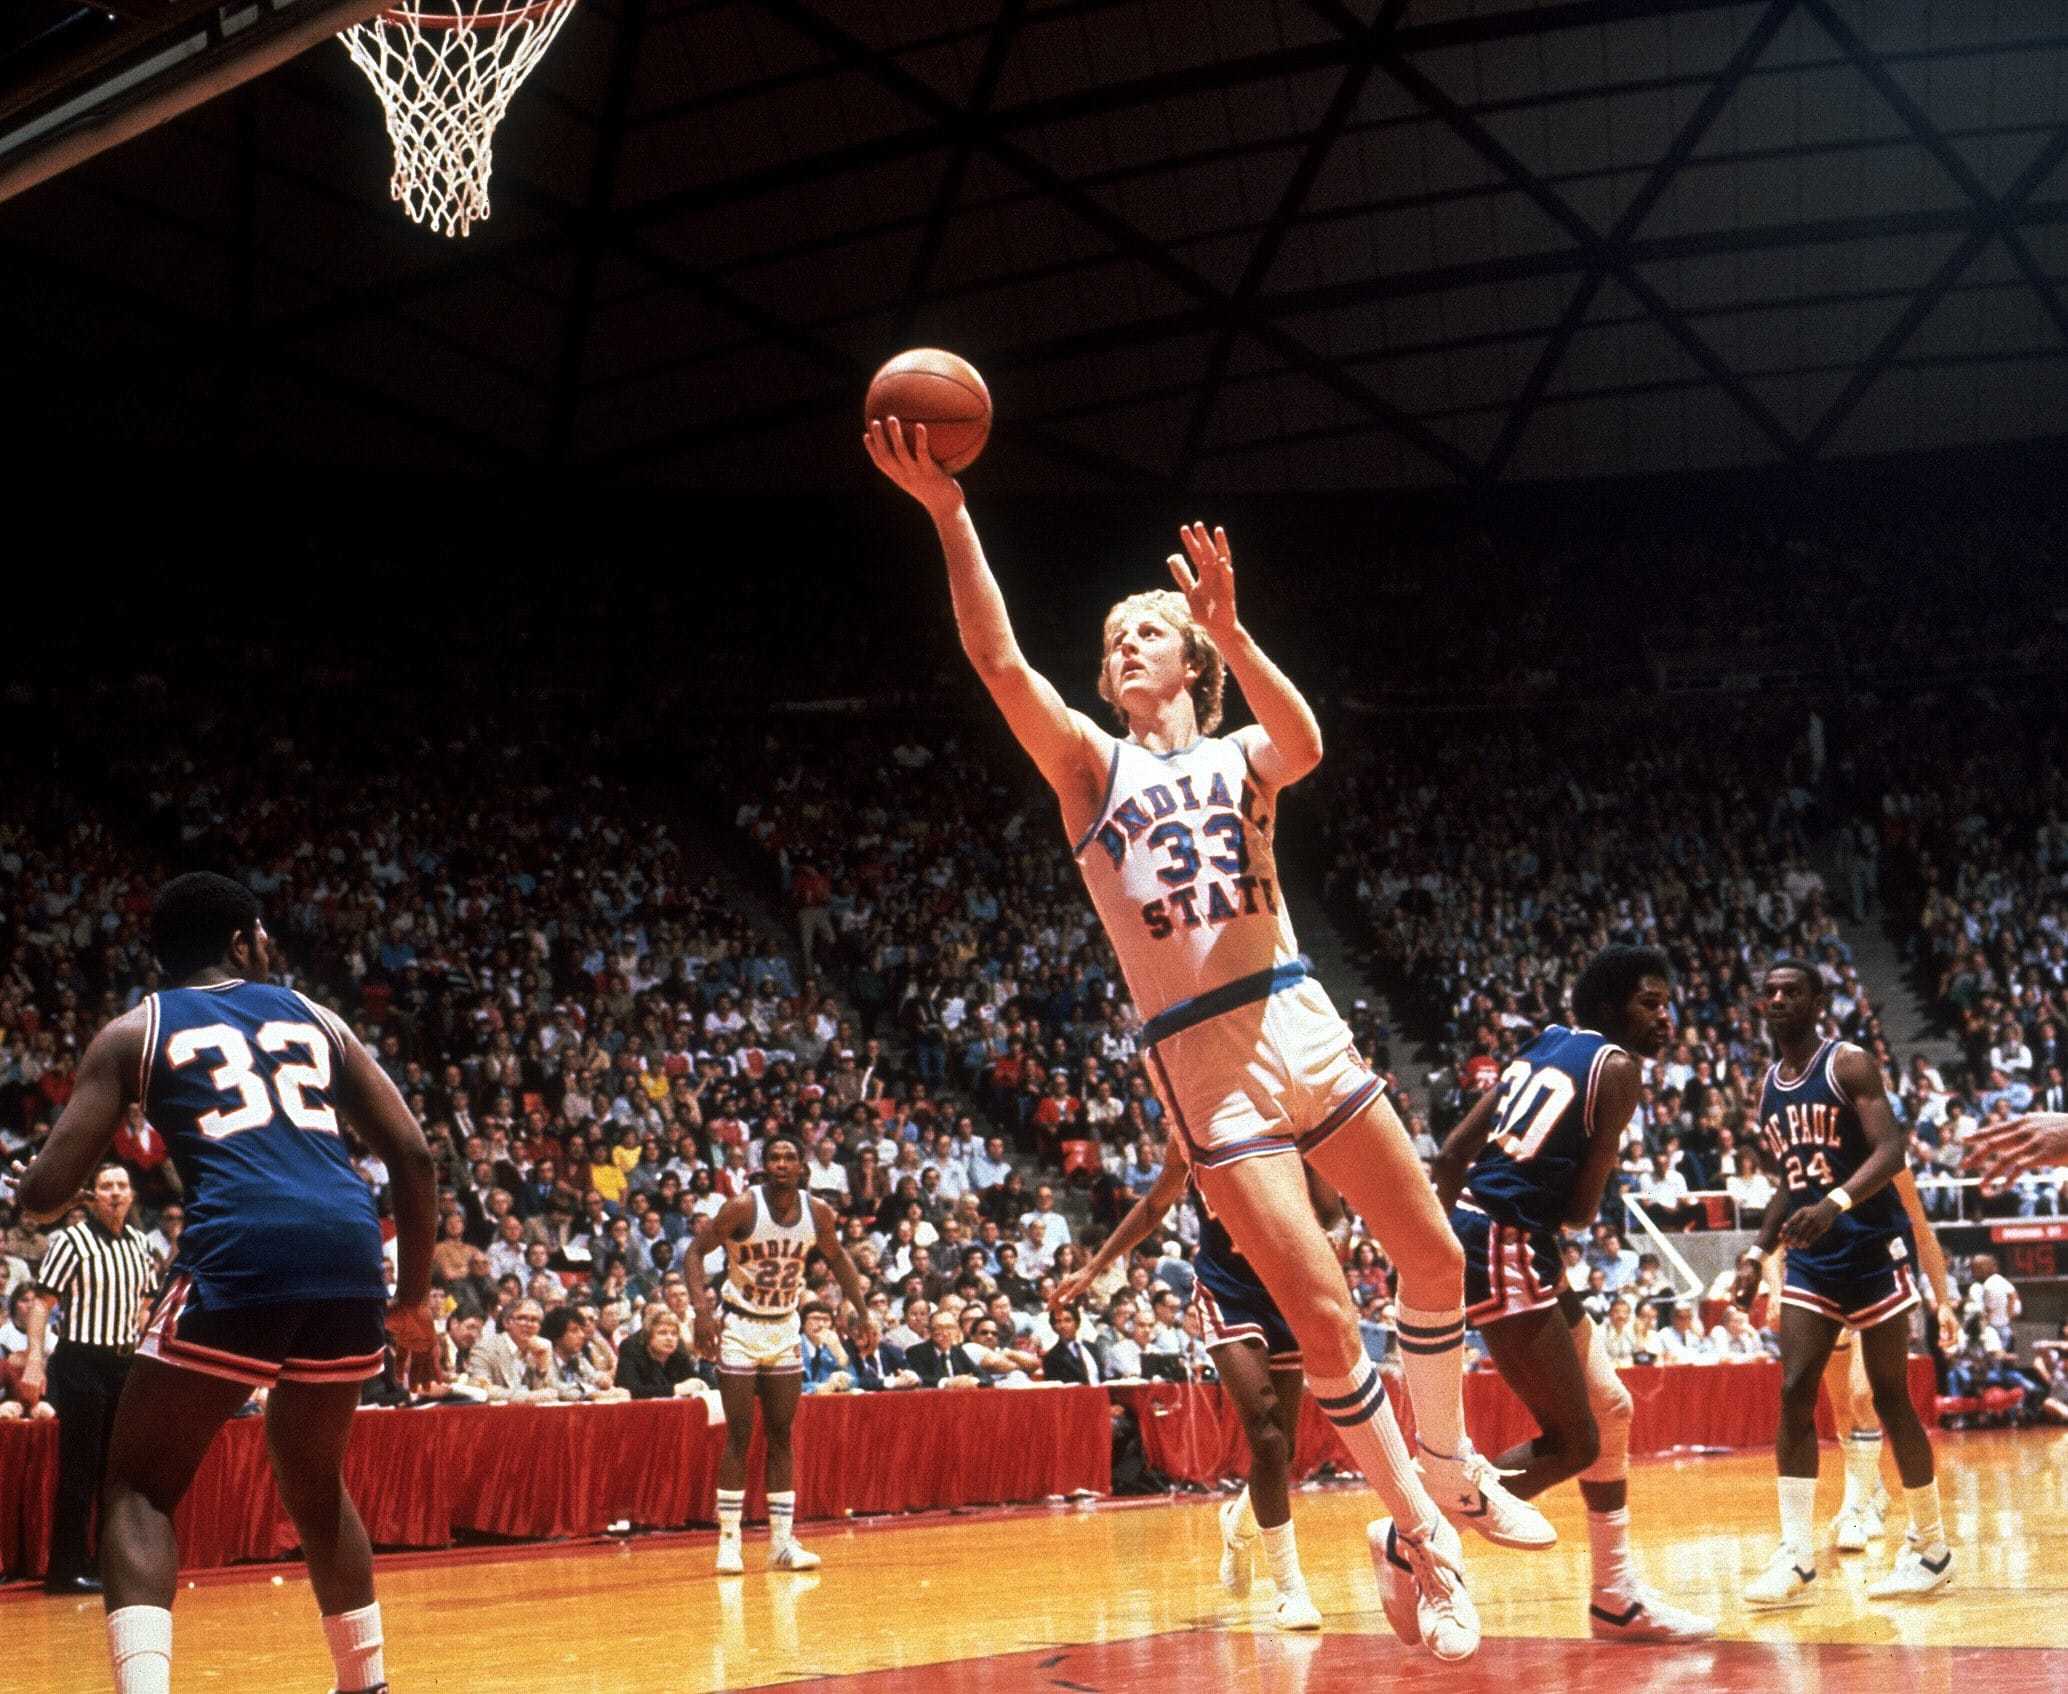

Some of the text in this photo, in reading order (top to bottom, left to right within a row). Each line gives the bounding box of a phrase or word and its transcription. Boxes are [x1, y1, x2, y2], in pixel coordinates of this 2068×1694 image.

[1148, 814, 1250, 884] 33
[165, 1020, 341, 1140] 32
[1487, 1059, 1576, 1162] 30
[1785, 1103, 1841, 1147] PAUL
[1785, 1151, 1834, 1191] 24
[755, 1260, 801, 1289] 22
